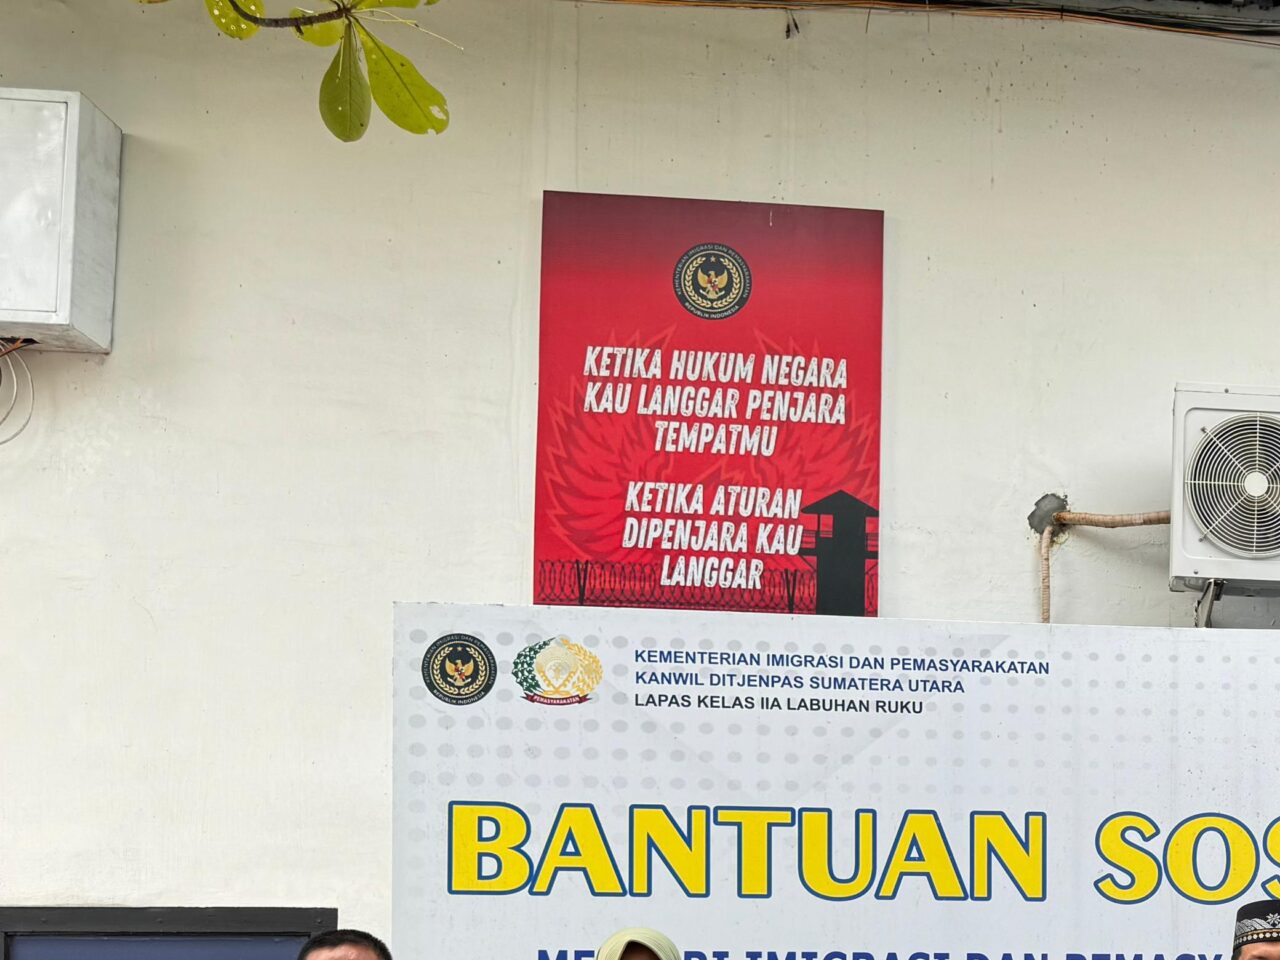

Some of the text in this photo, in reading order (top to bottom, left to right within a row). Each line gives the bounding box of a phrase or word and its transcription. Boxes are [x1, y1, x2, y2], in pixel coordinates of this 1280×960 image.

[583, 346, 848, 388] KETIKA HUKUM NEGARA
[583, 382, 846, 424] KAU LANGGAR PENJARA
[655, 420, 778, 457] TEMPATMU
[625, 481, 802, 519] KETIKA ATURAN
[622, 517, 804, 555] DIPENJARA KAU
[660, 554, 764, 589] LANGGAR
[635, 650, 1050, 674] KEMENTERIAN IMIGRASI DAN PEMASYARAKATAN
[635, 672, 965, 693] KANWIL DITJENPAS SUMATERA UTARA
[635, 693, 924, 713] LAPAS KELAS IIA LABUHAN RUKU
[448, 801, 1046, 901] BANTUAN
